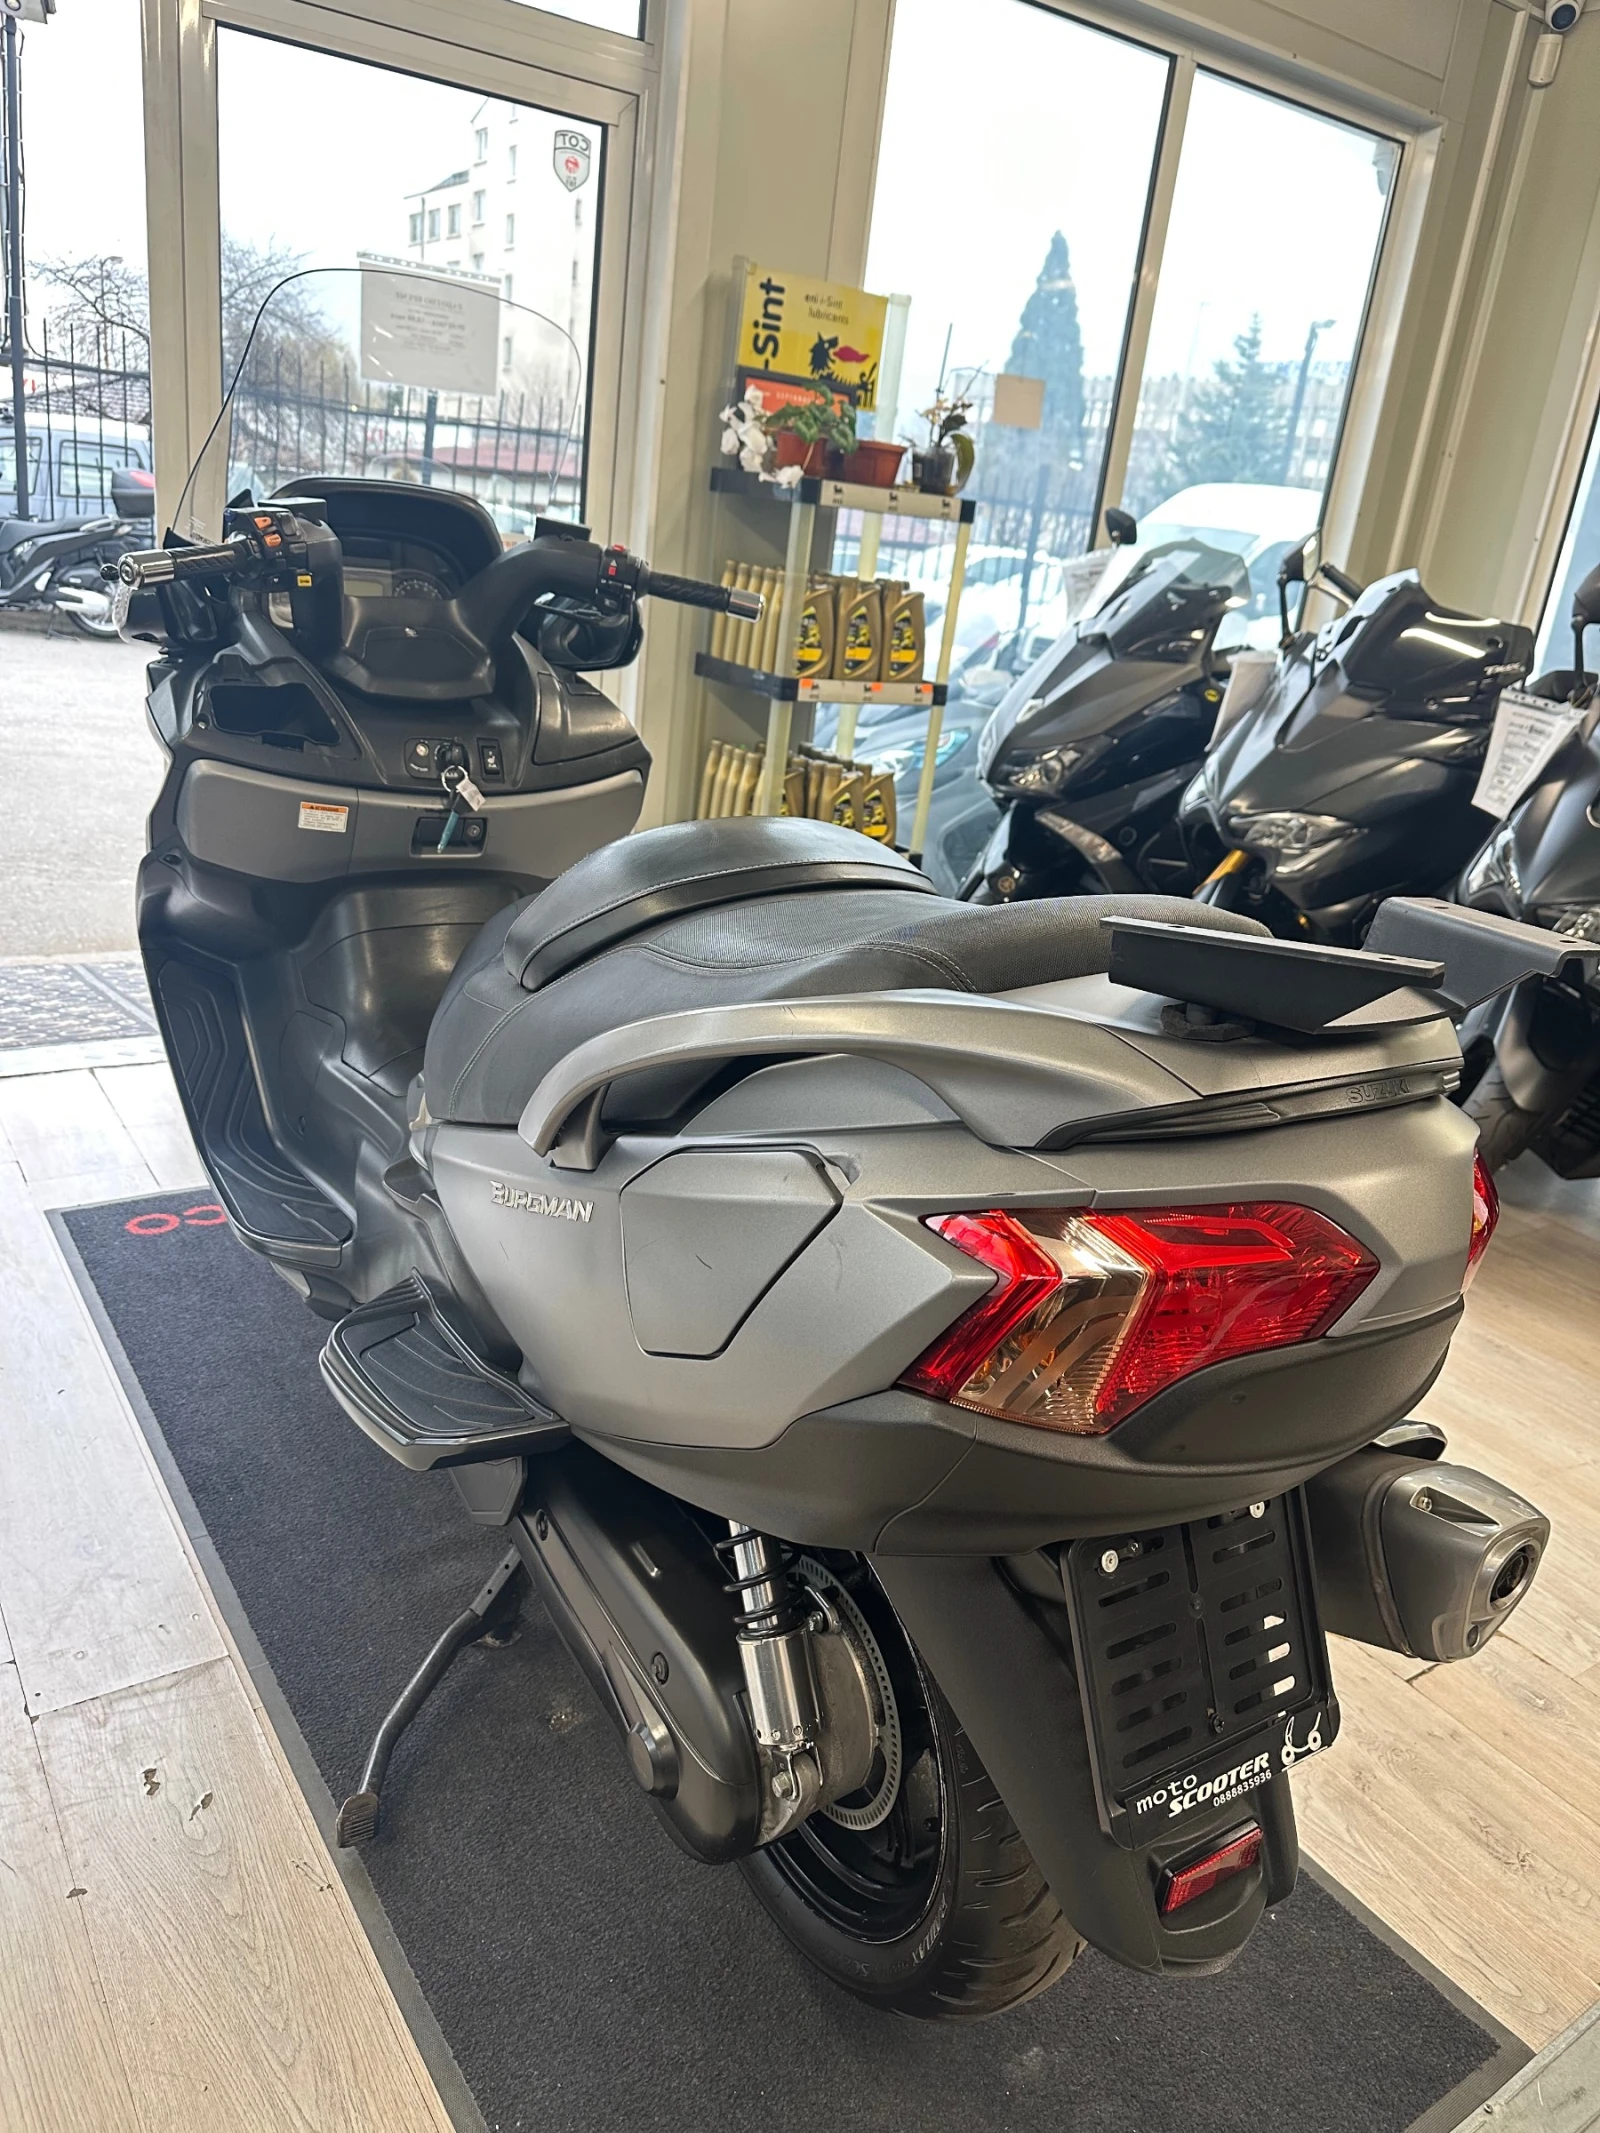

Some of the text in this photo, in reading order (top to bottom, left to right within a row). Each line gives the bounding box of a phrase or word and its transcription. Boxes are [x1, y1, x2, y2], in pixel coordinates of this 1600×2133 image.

[808, 305, 849, 325] lubricants
[1346, 1079, 1410, 1103] SUZUKI
[490, 1181, 594, 1223] BURGMAN
[1136, 1774, 1197, 1815] moto
[1168, 1752, 1269, 1818] SCOOTER
[1213, 1769, 1272, 1807] 0888835936
